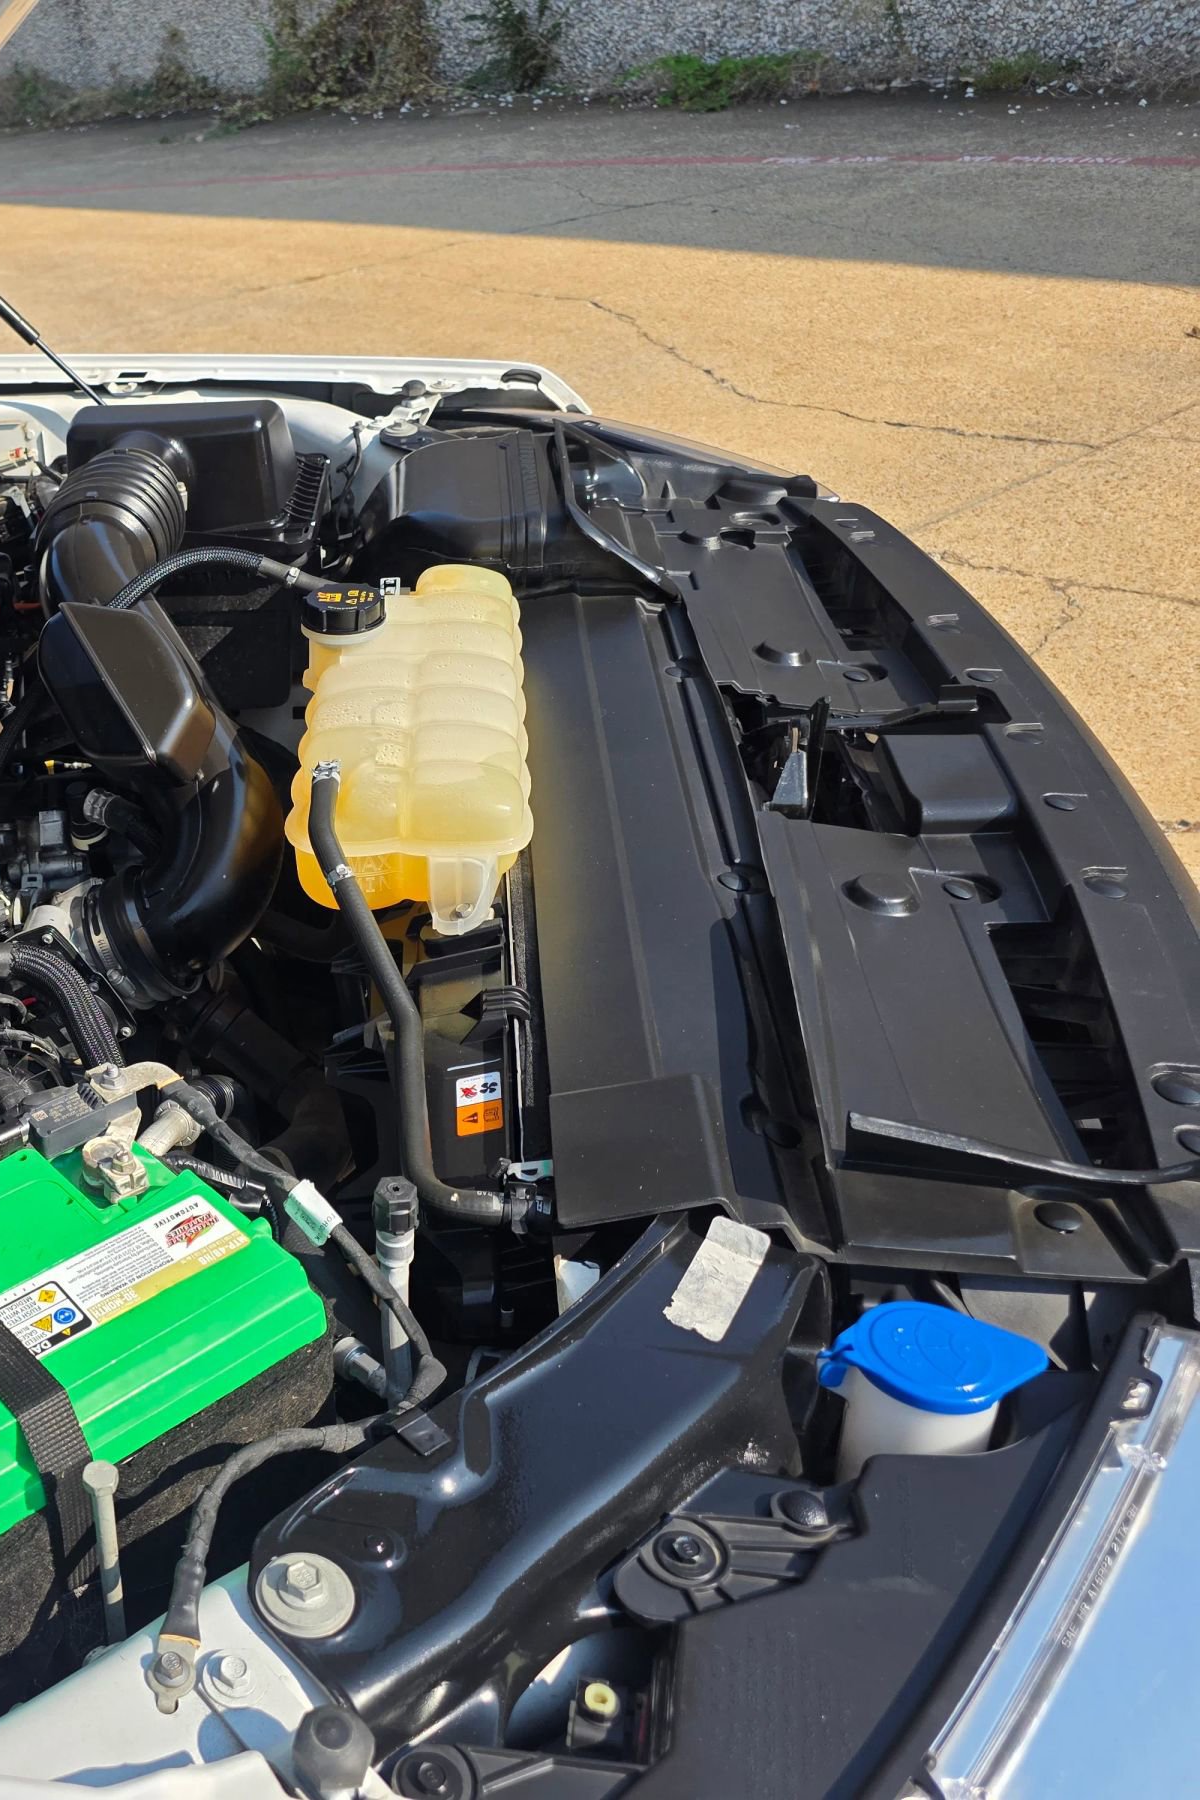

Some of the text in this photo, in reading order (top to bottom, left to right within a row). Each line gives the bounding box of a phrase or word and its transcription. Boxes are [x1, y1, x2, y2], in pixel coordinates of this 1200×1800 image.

[347, 855, 390, 872] MAX
[154, 1203, 199, 1228] AUTOMOTIVE
[164, 1212, 213, 1240] BATTERIES
[165, 1215, 221, 1248] INTERSTATE
[136, 1257, 174, 1279] PROPOSITION
[100, 1281, 129, 1298] WARNING
[2, 1301, 38, 1321] ATELY WITH
[5, 1295, 33, 1313] MEDICAL
[6, 1305, 42, 1327] FLUSH EYES
[24, 1331, 48, 1347] SHIELD
[1061, 1624, 1080, 1648] SAE
[1075, 1602, 1091, 1620] HR
[1125, 1503, 1140, 1520] RH
